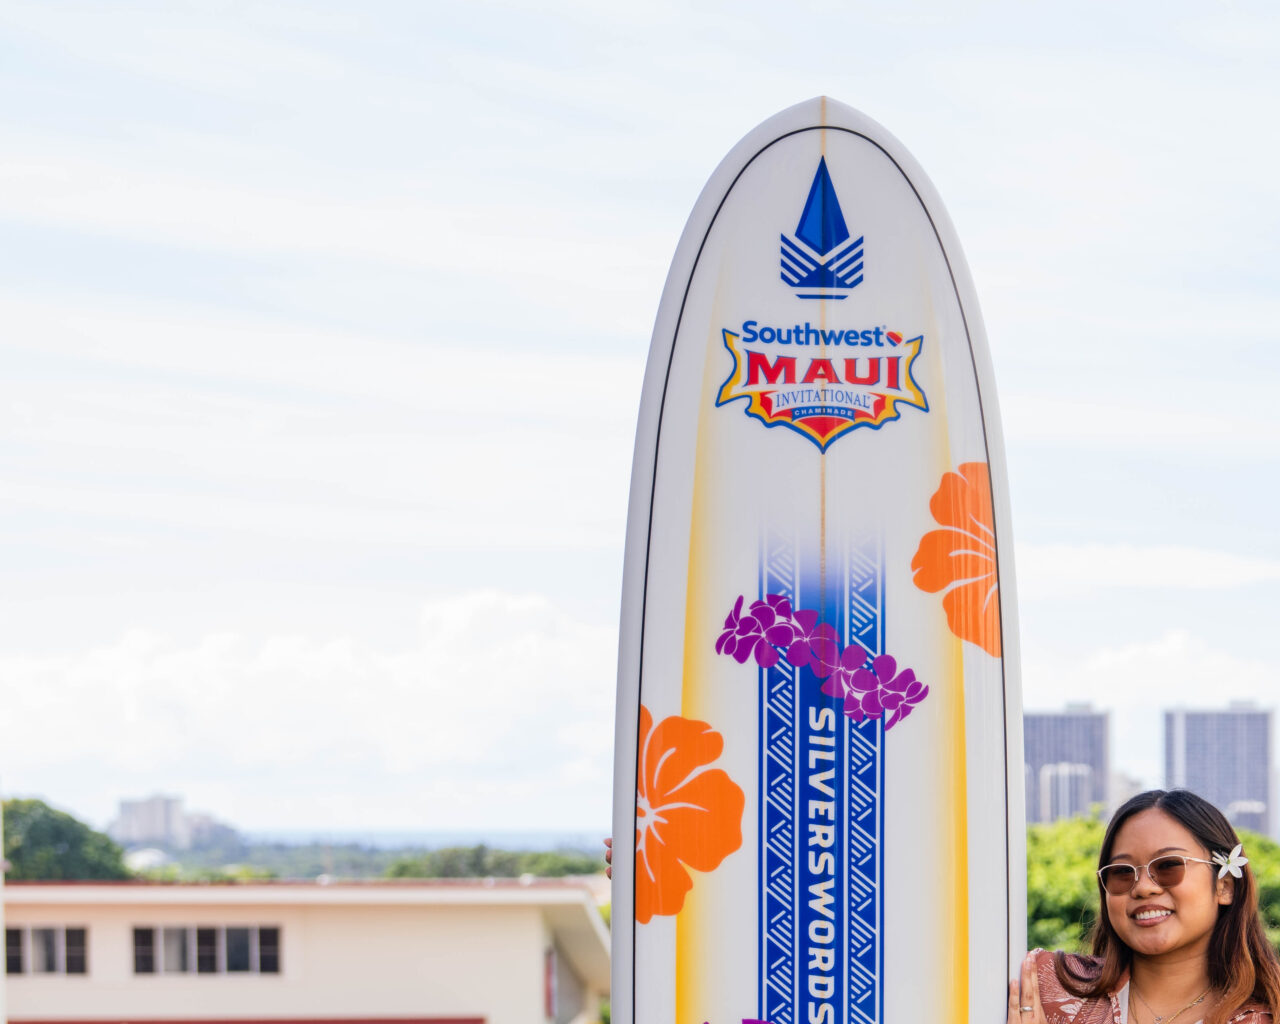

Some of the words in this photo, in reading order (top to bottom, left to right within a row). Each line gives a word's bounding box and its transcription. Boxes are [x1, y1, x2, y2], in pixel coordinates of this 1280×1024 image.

[742, 320, 884, 347] Southwest
[743, 348, 902, 391] MAUI
[775, 388, 870, 409] INVITATIONAL
[794, 407, 853, 416] CHAMINADE
